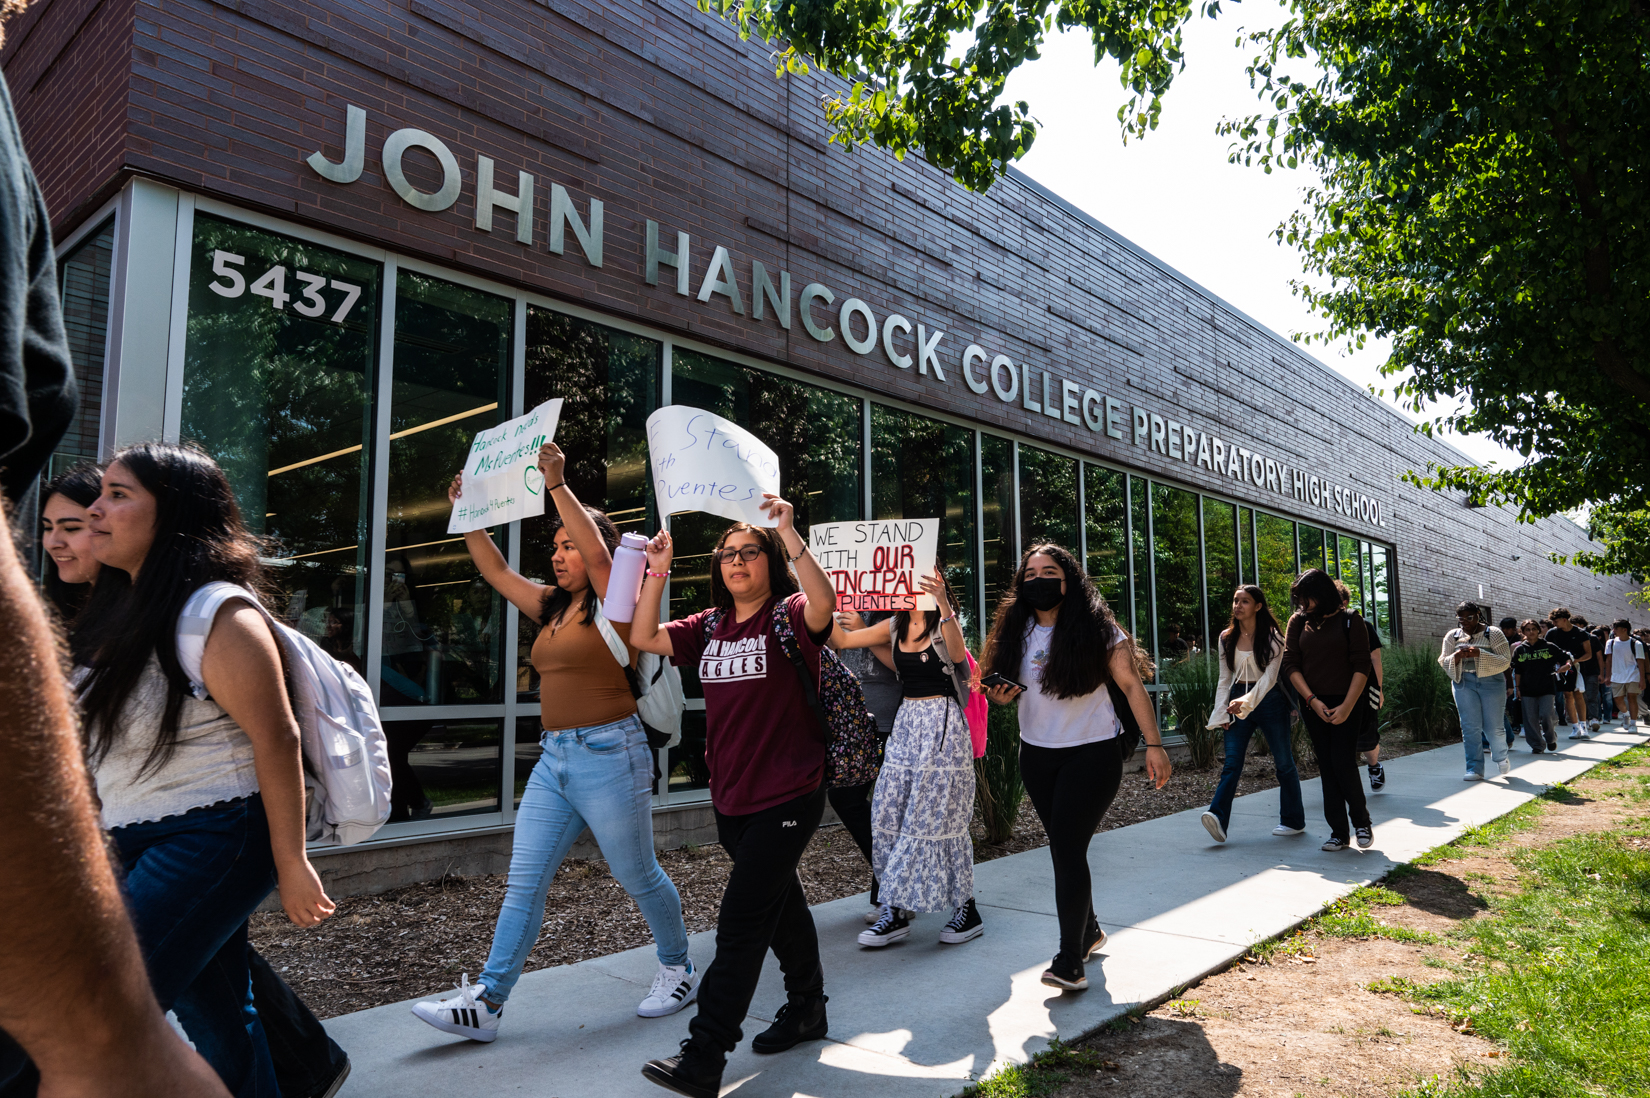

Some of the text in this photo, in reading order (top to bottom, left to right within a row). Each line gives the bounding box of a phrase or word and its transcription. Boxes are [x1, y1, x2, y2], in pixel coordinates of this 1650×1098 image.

[208, 249, 361, 323] 5437
[306, 104, 1386, 527] JOHN HANCOCK COLLEGE PREPARATORY HIGH SCHOOL
[470, 411, 539, 454] Hancock needs
[650, 414, 779, 478] E Stand
[813, 521, 924, 547] WE STAND
[872, 544, 915, 571] OUR
[827, 568, 926, 595] INCIPAL
[841, 594, 917, 611] PUENTES
[701, 656, 764, 678] AGLES
[782, 820, 797, 828] FILA
